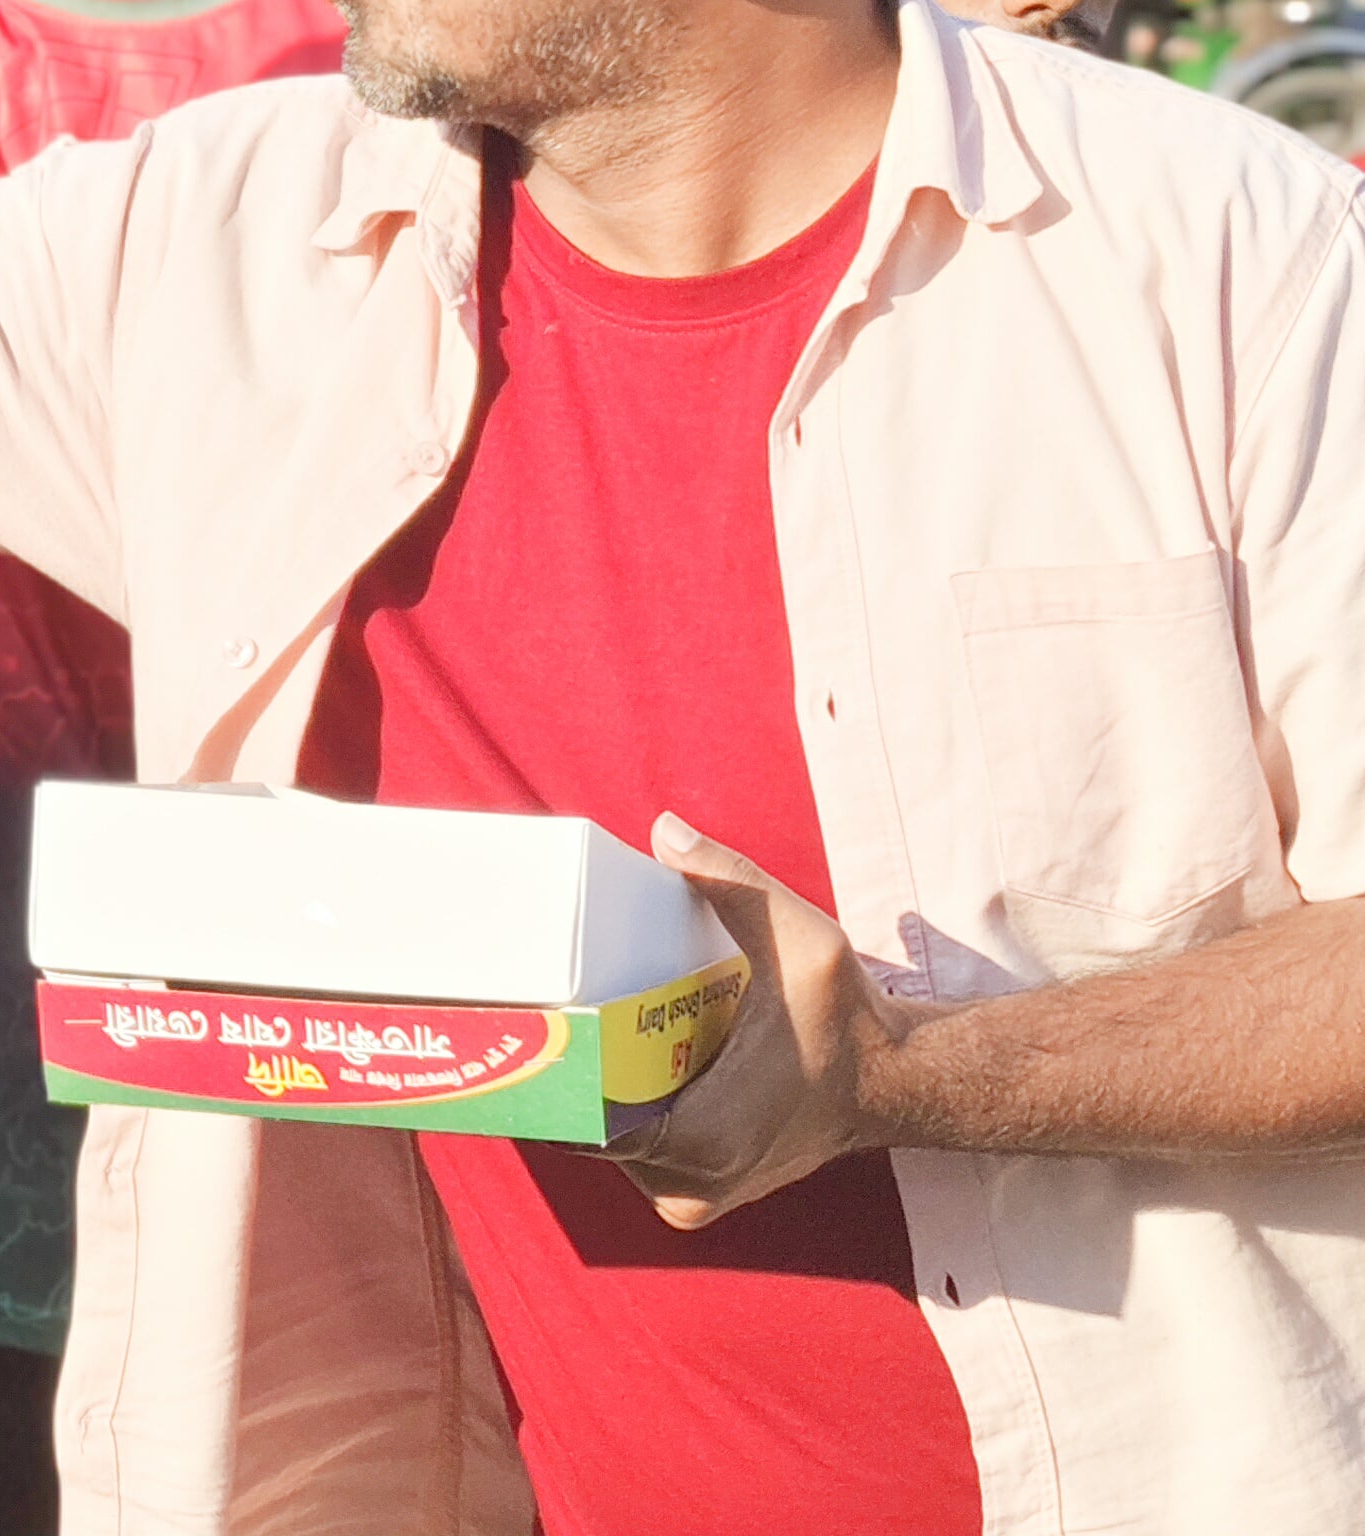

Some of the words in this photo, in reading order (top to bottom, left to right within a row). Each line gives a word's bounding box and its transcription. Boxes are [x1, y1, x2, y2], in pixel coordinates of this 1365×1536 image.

[217, 1011, 292, 1051] ঘোষ
[304, 1018, 456, 1067] সাতক্ষীরা
[635, 1004, 665, 1040] Dairy
[243, 1052, 328, 1097] আদি
